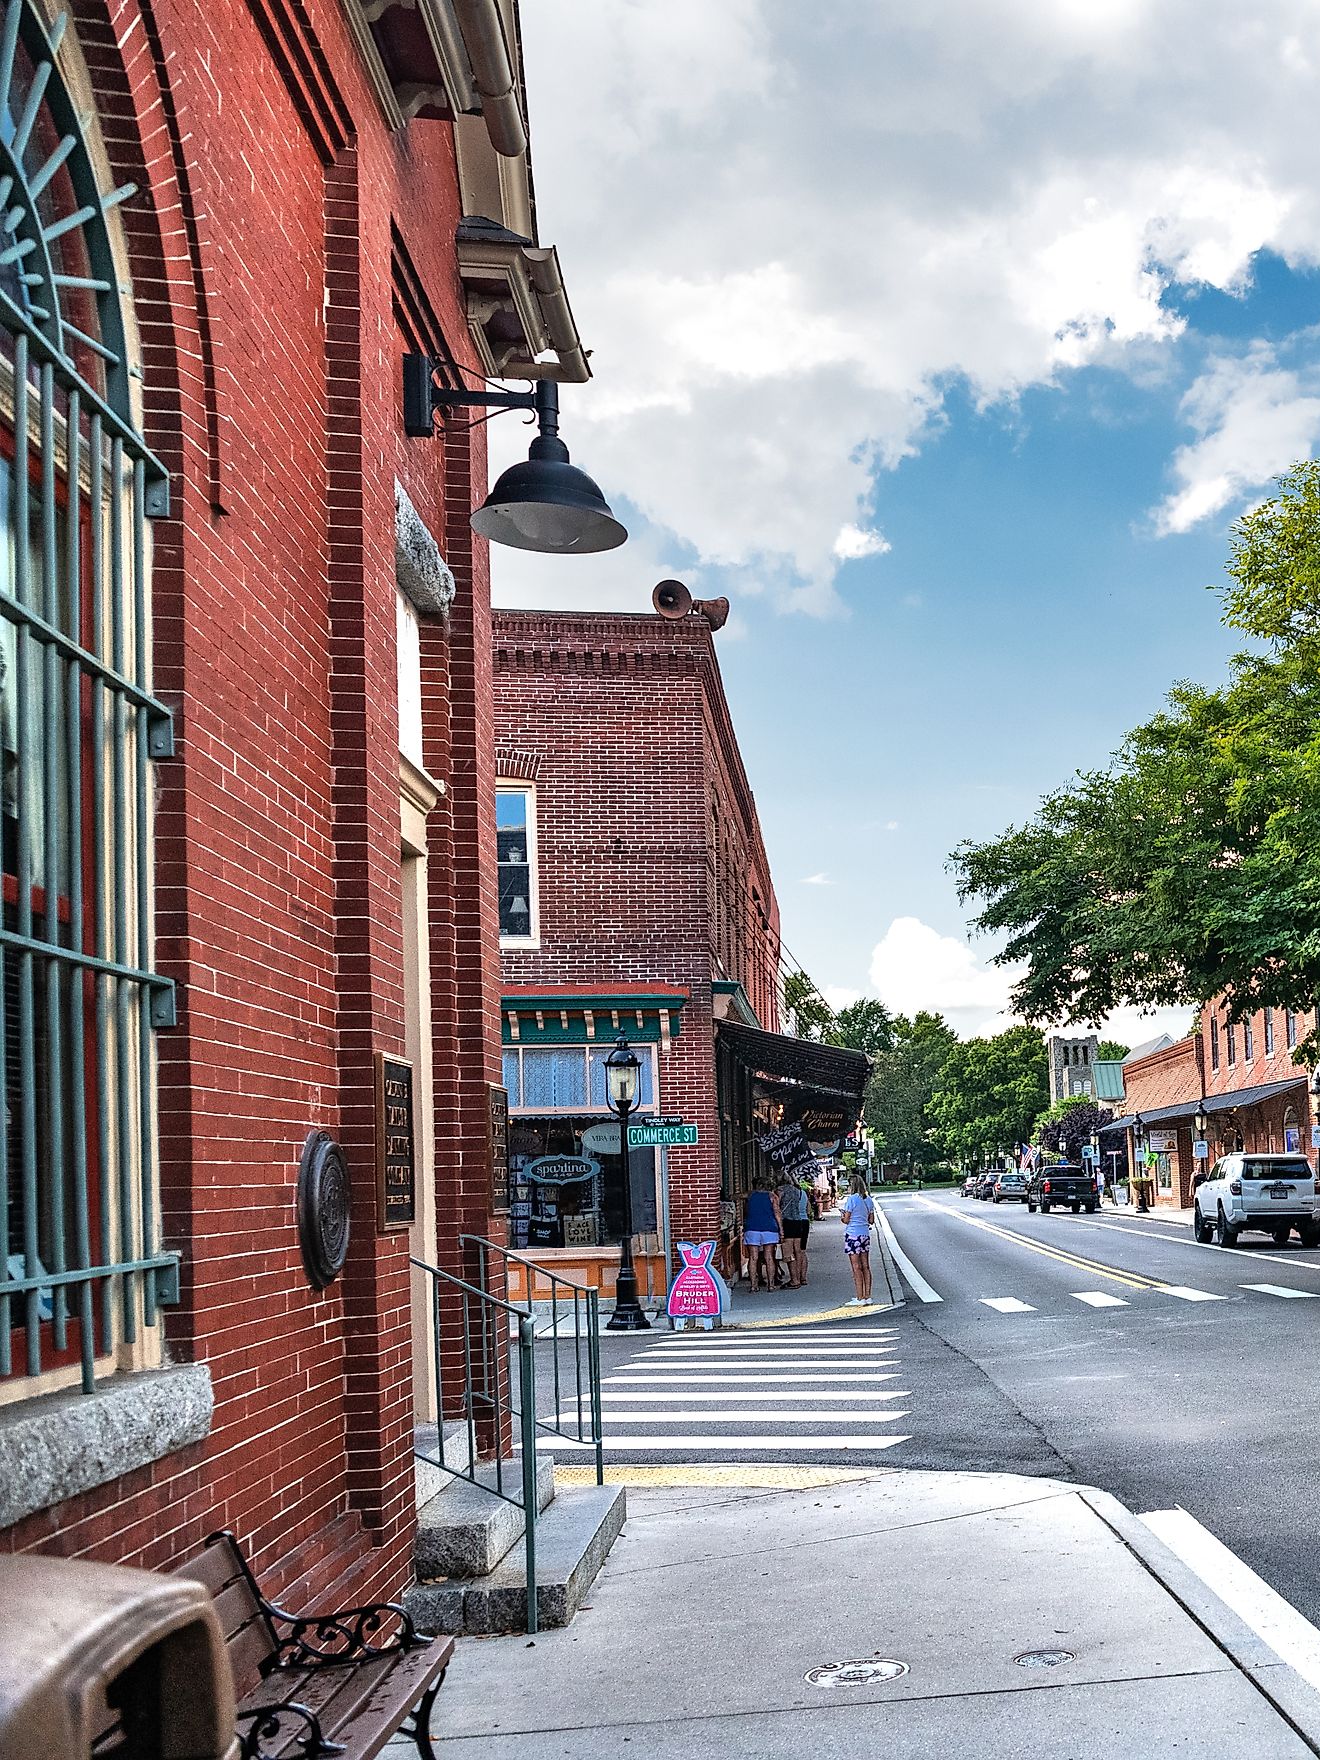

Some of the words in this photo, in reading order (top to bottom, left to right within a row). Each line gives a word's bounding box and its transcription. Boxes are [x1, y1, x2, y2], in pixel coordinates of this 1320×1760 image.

[801, 1109, 843, 1120] Victorian
[807, 1120, 840, 1129] Charm
[630, 1127, 680, 1144] COMMERCE
[683, 1127, 694, 1142] ST
[771, 1136, 803, 1163] open
[536, 1161, 588, 1177] spartina
[568, 1235, 591, 1243] WINE
